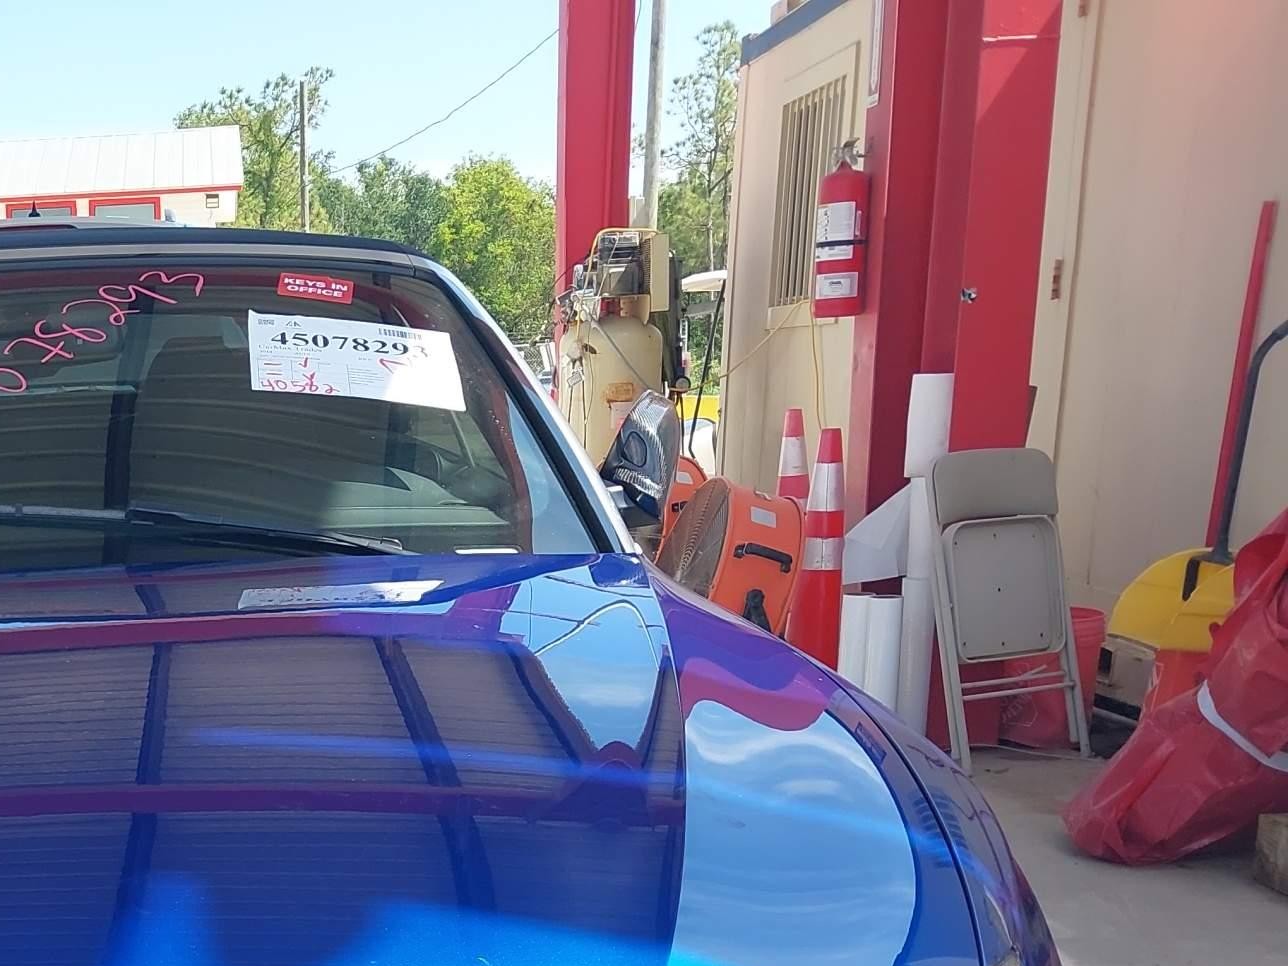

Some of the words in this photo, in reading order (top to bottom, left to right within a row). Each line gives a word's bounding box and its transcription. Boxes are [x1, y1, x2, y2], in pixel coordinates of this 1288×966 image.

[284, 277, 326, 288] KEYS
[331, 283, 348, 291] IN
[287, 285, 343, 298] OFFICE
[271, 331, 428, 358] 45078293
